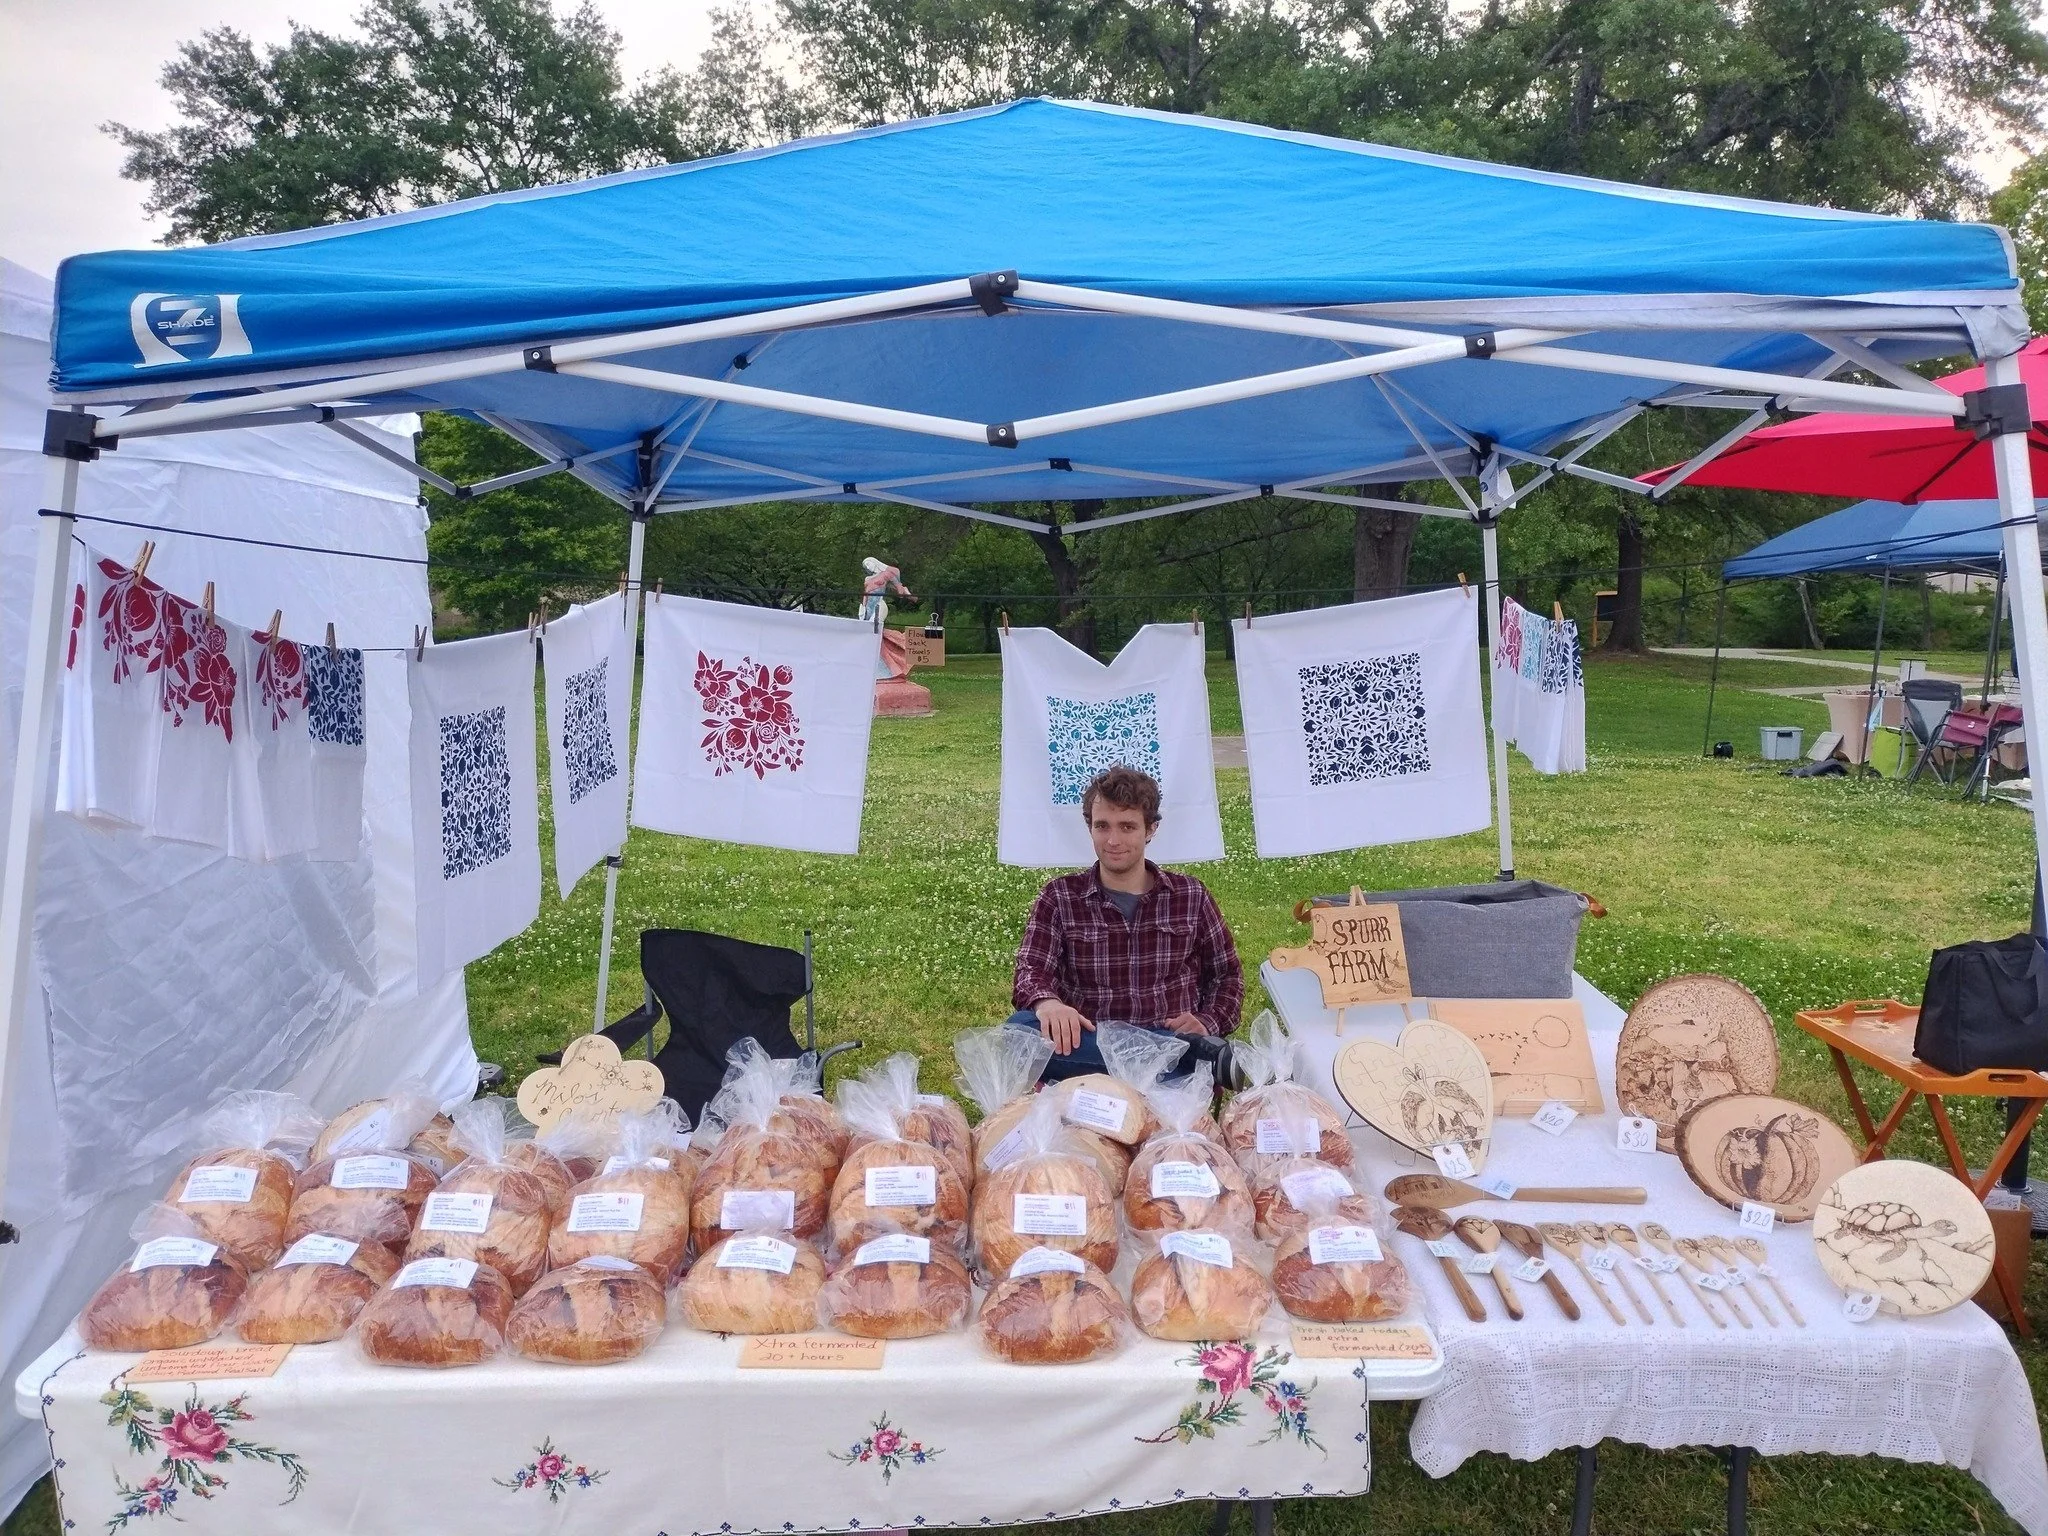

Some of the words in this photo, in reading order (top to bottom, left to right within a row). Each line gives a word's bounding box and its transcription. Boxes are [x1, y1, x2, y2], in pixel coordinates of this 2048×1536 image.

[157, 318, 215, 330] SHADE
[908, 629, 925, 638] Flou
[908, 639, 927, 647] Sack
[906, 647, 931, 655] Towels
[917, 655, 930, 663] $5
[1331, 915, 1392, 946] SPURR
[1325, 947, 1390, 986] FARM
[1540, 1111, 1564, 1126] $20
[1621, 1130, 1649, 1148] $30
[1743, 1210, 1771, 1227] $20
[1370, 1327, 1411, 1338] today
[754, 1338, 798, 1350] Xtra
[803, 1337, 878, 1350] fermented
[1331, 1343, 1395, 1353] fermented
[800, 1352, 845, 1361] hours
